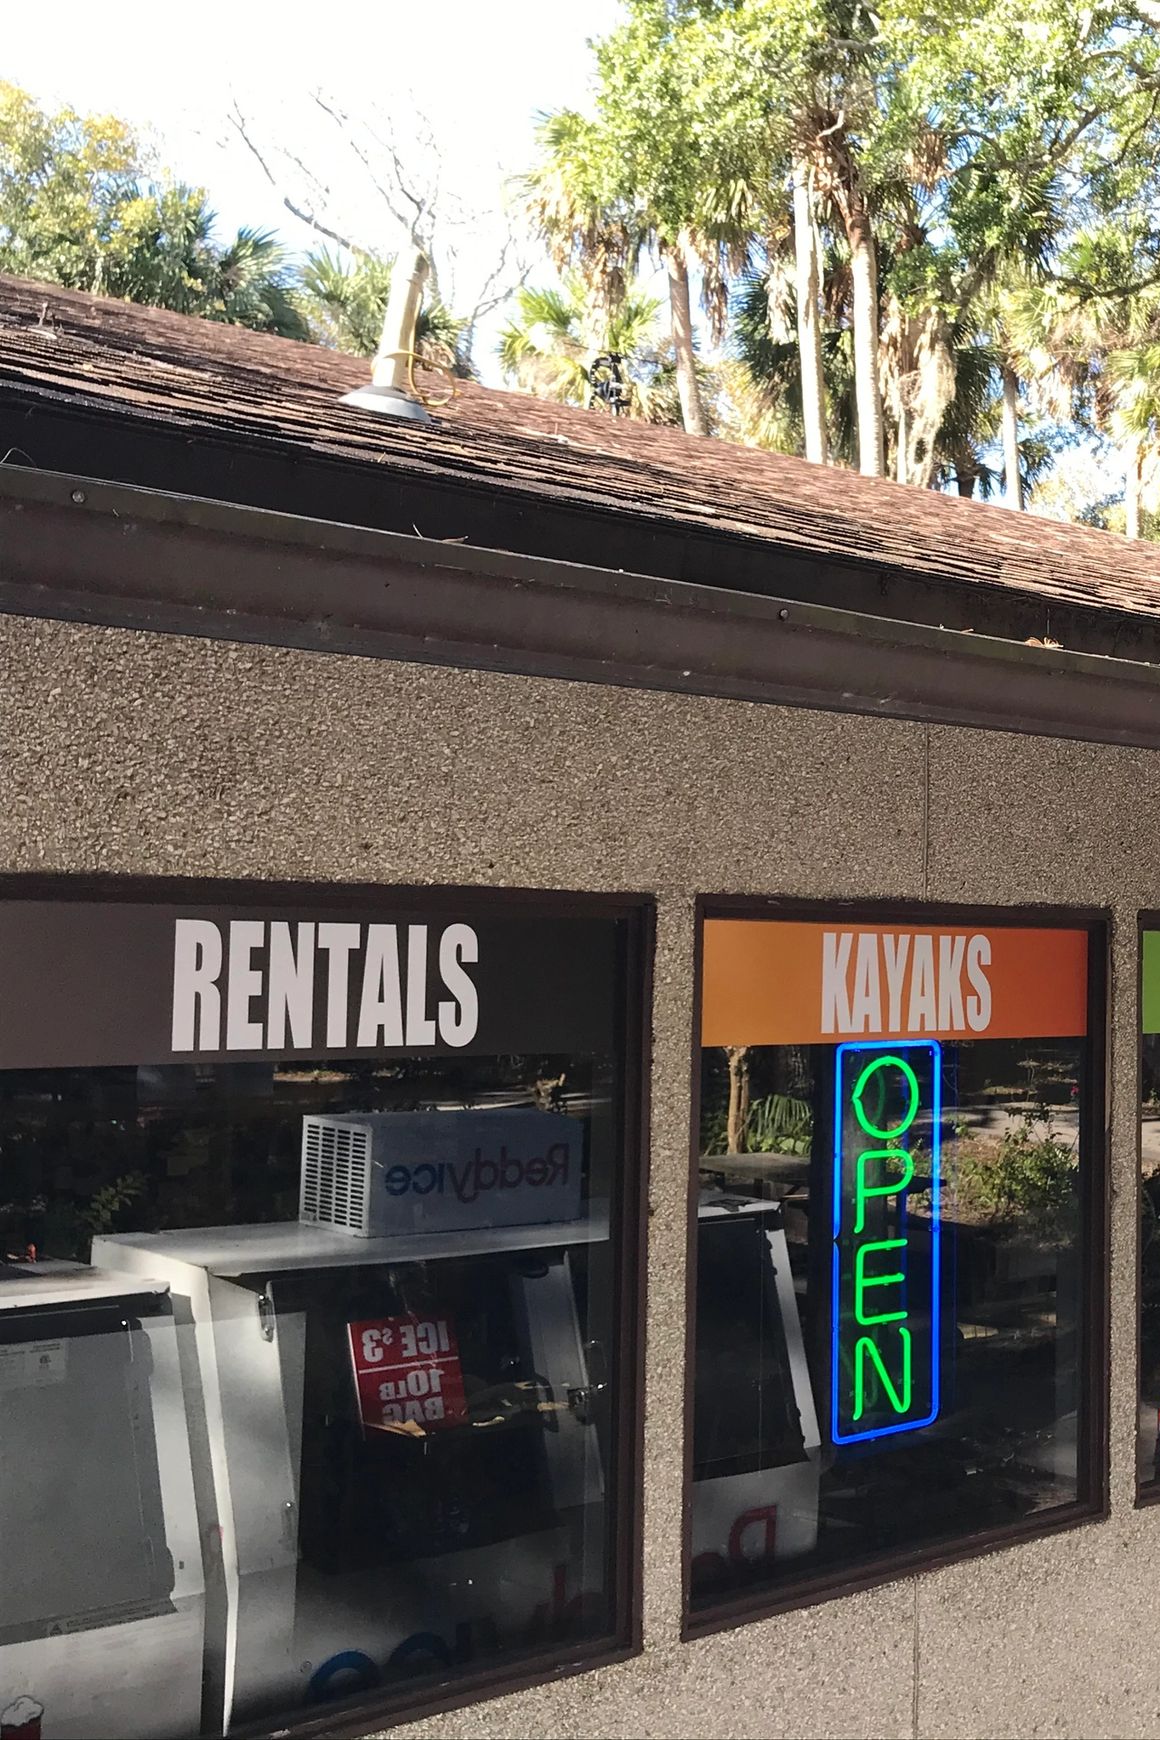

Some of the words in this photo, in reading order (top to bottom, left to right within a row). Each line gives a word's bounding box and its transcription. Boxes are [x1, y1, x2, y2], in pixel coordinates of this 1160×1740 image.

[170, 917, 480, 1053] RENTALS
[820, 931, 992, 1035] KAYAKS
[853, 1054, 920, 1423] OPEN
